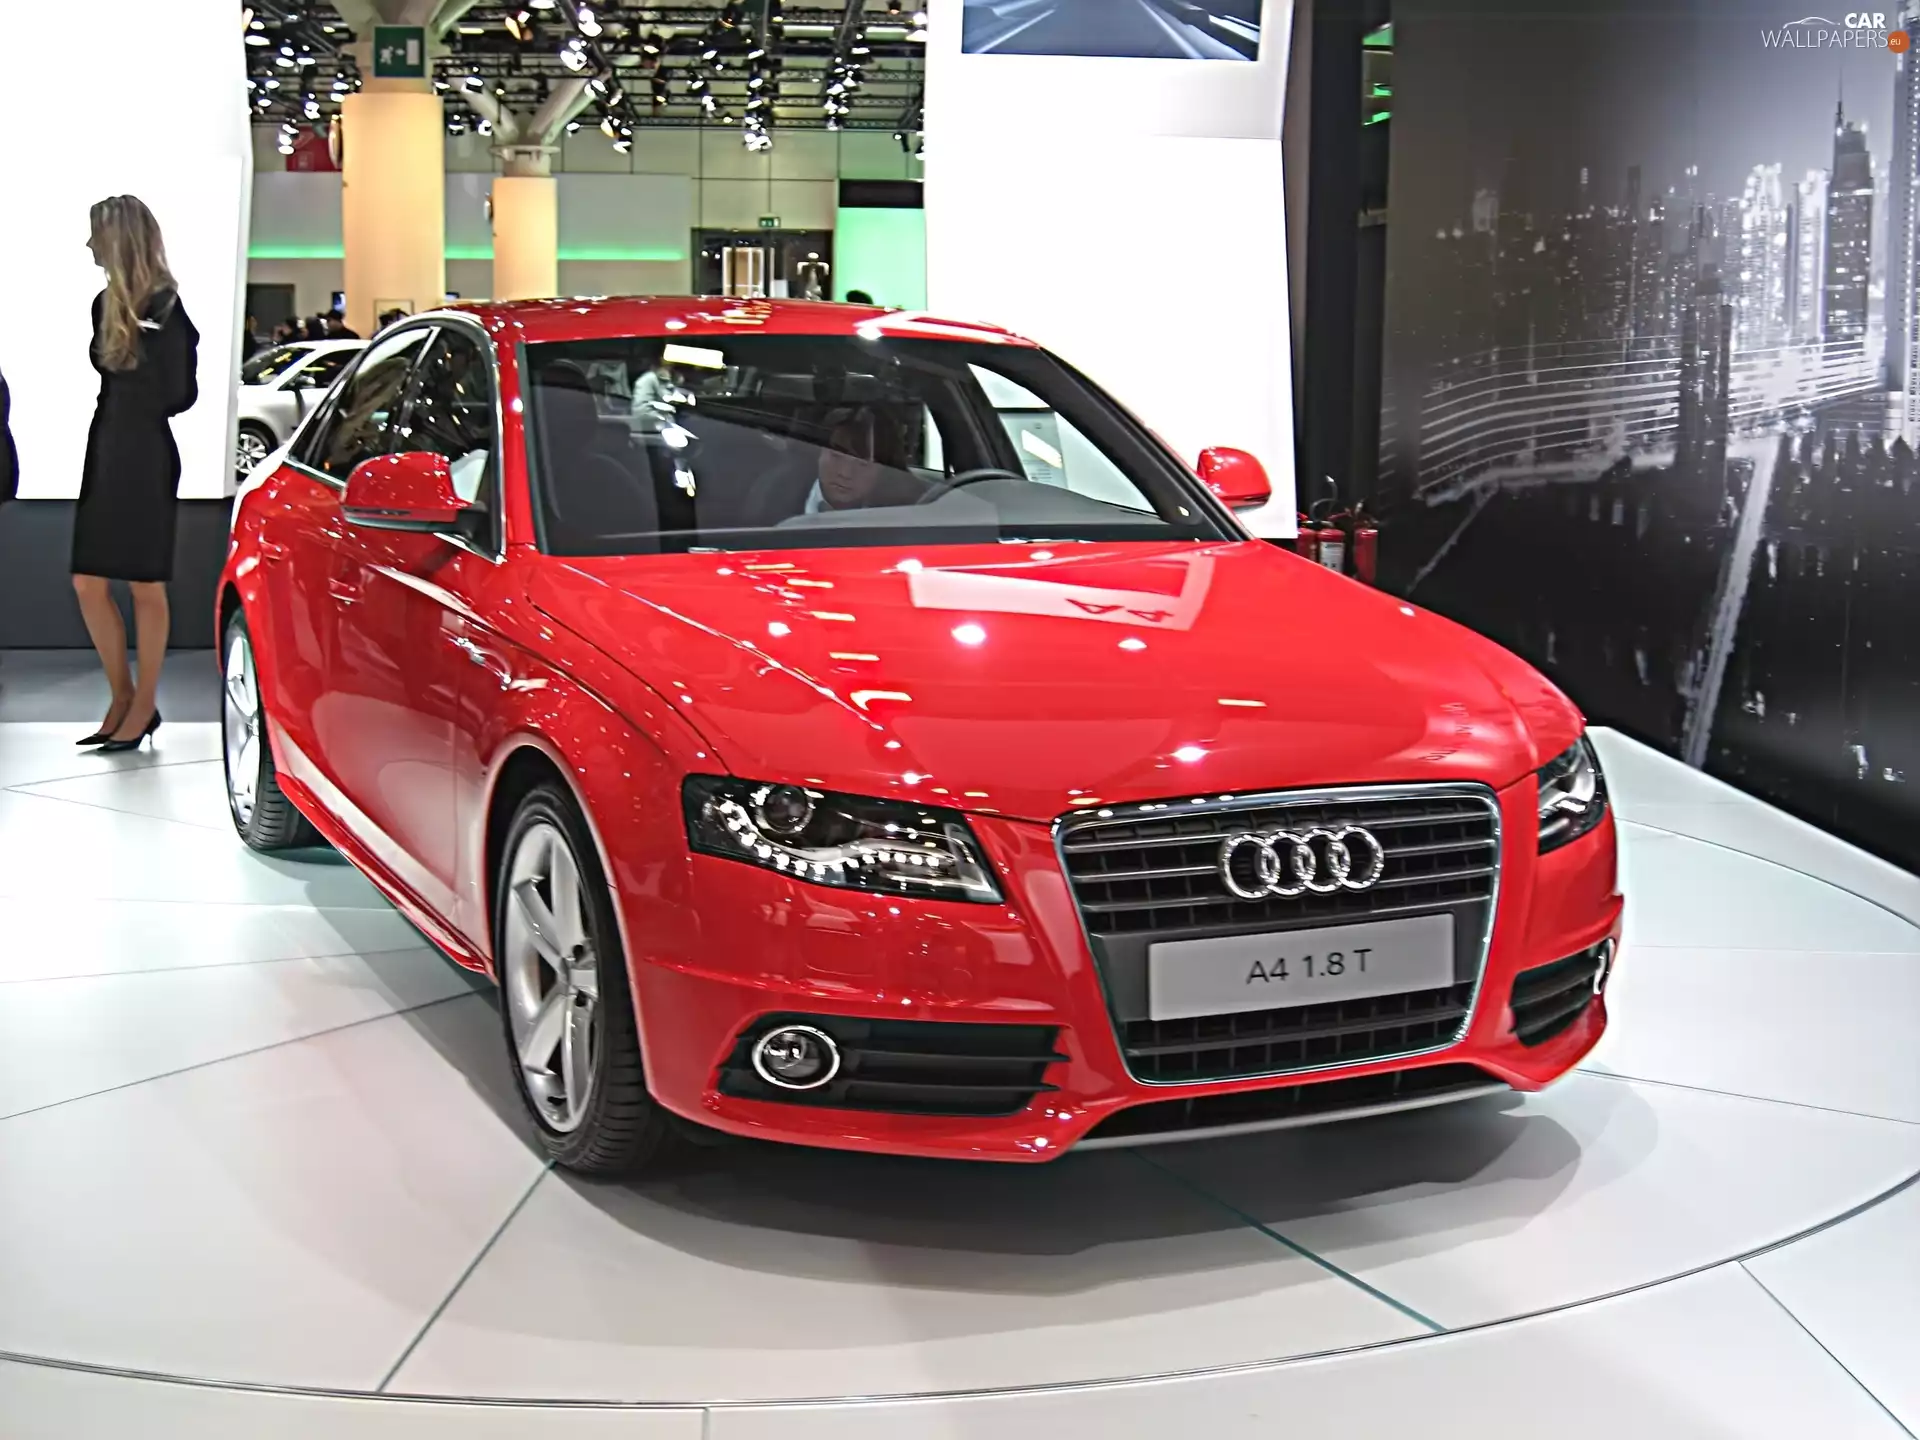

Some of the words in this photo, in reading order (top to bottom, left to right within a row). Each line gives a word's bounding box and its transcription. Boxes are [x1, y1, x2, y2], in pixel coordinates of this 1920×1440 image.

[1246, 957, 1290, 984] A4
[1302, 952, 1345, 977] 1.8
[1352, 948, 1373, 972] T
